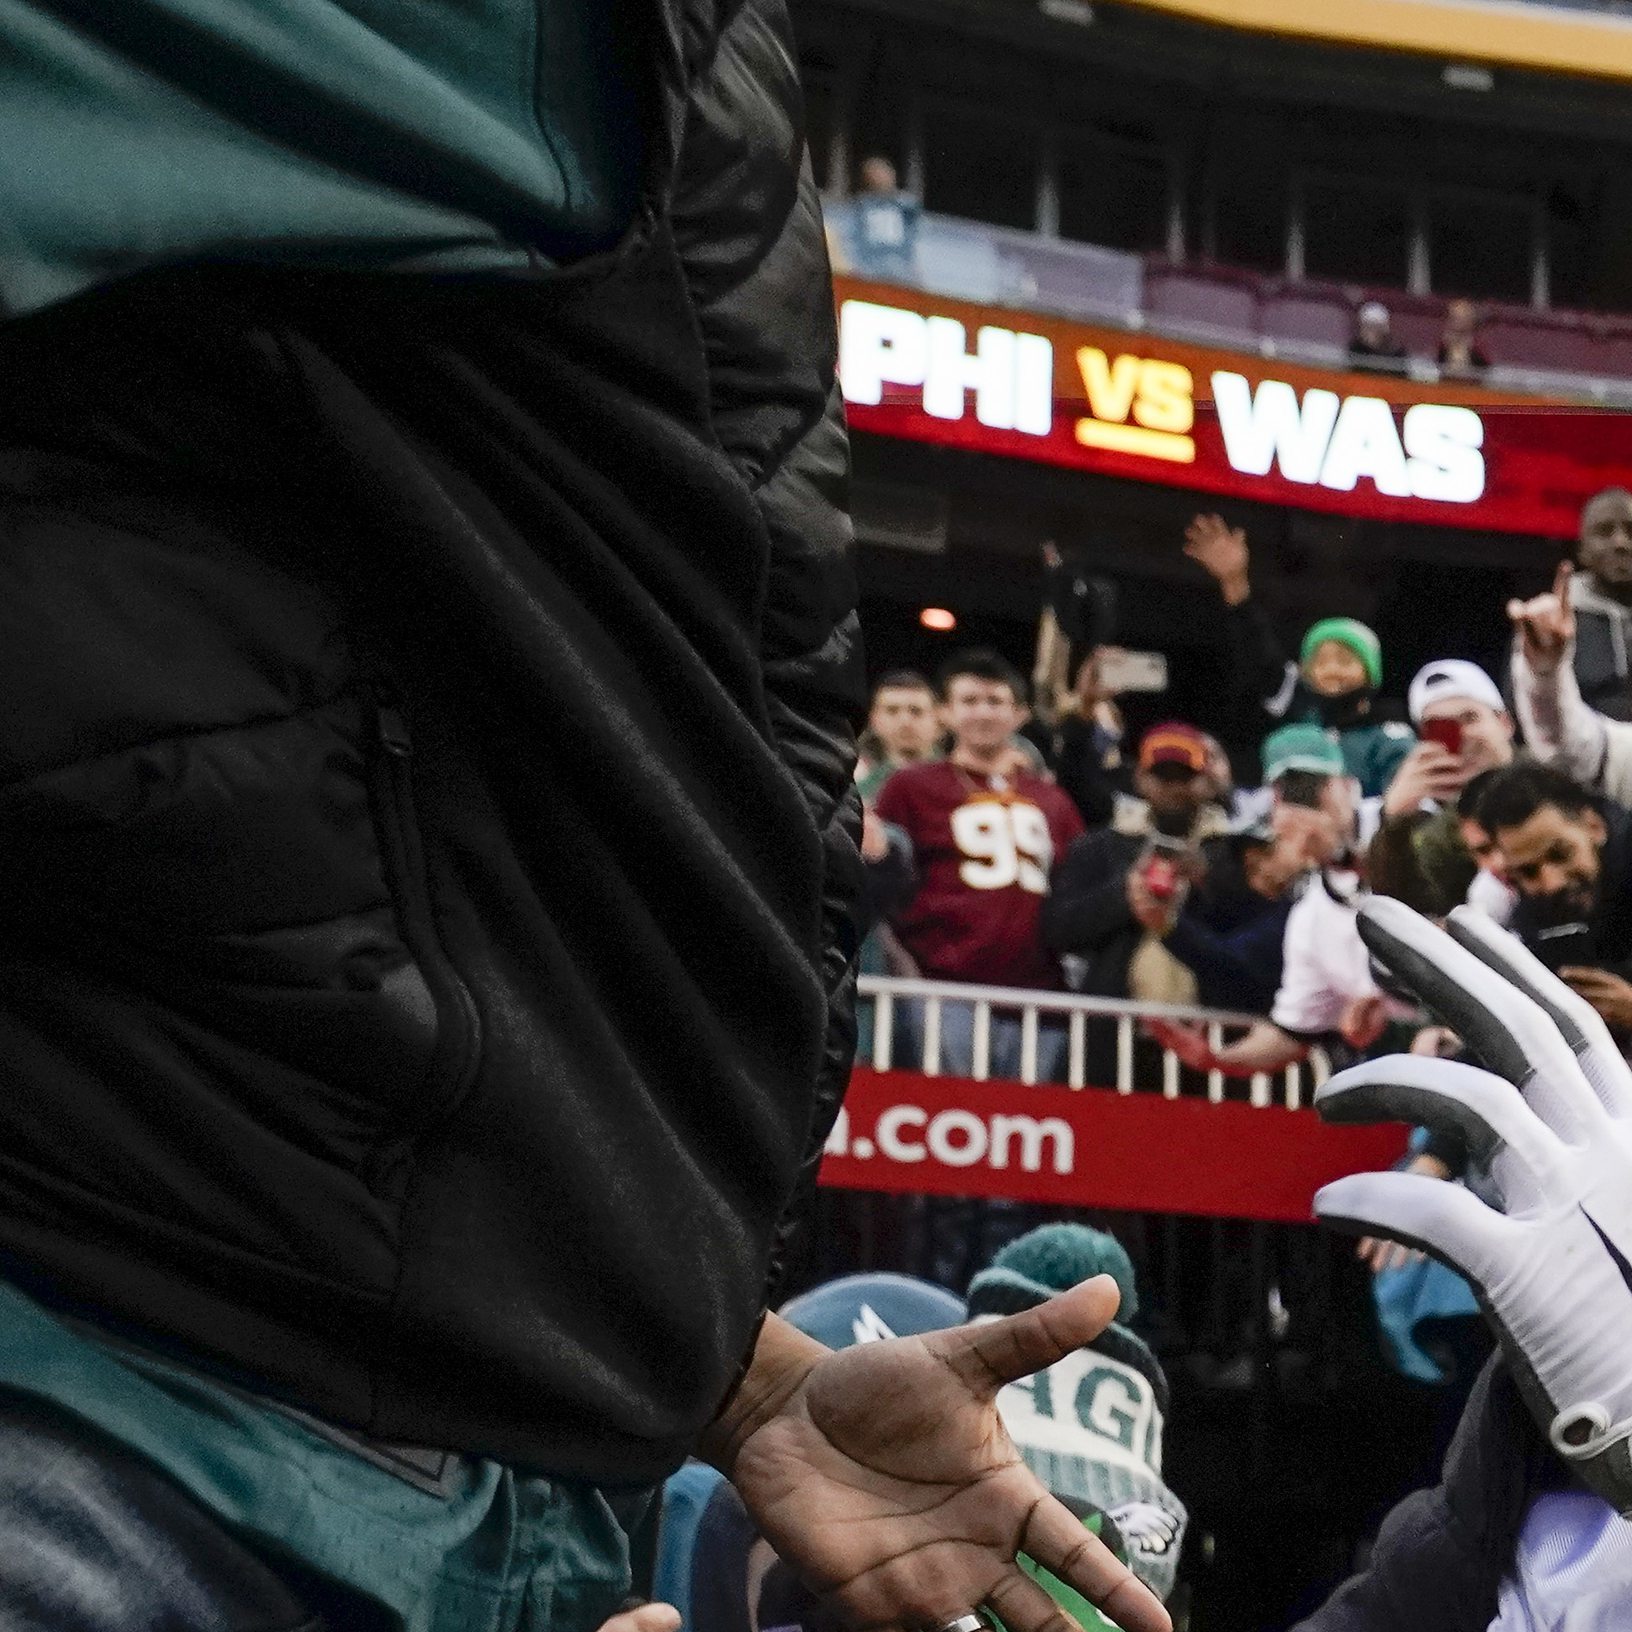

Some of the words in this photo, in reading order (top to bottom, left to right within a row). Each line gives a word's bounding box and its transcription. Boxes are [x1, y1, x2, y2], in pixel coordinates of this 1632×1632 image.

[841, 300, 1053, 436] PHI
[1076, 344, 1194, 434] VS
[1211, 370, 1485, 504] WAS
[949, 801, 1055, 895] 99
